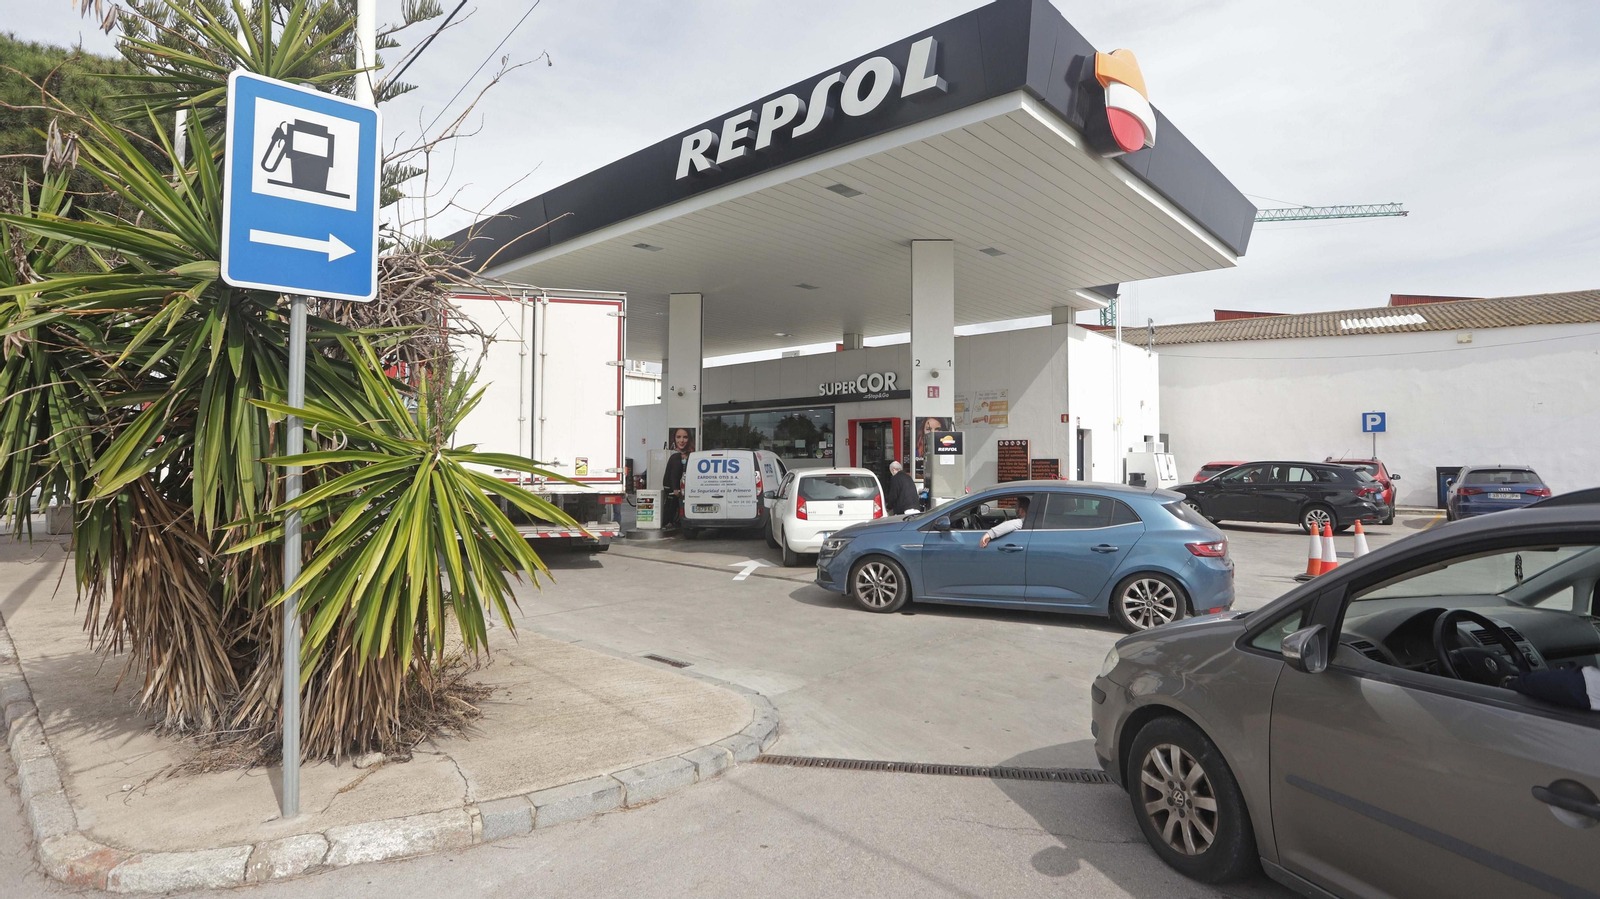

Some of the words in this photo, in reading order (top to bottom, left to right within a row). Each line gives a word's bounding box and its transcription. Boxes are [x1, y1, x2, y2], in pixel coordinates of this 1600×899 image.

[675, 36, 942, 181] REPSOL
[819, 371, 897, 396] SUPERCOR
[1366, 415, 1381, 431] P
[697, 459, 740, 474] OTIS
